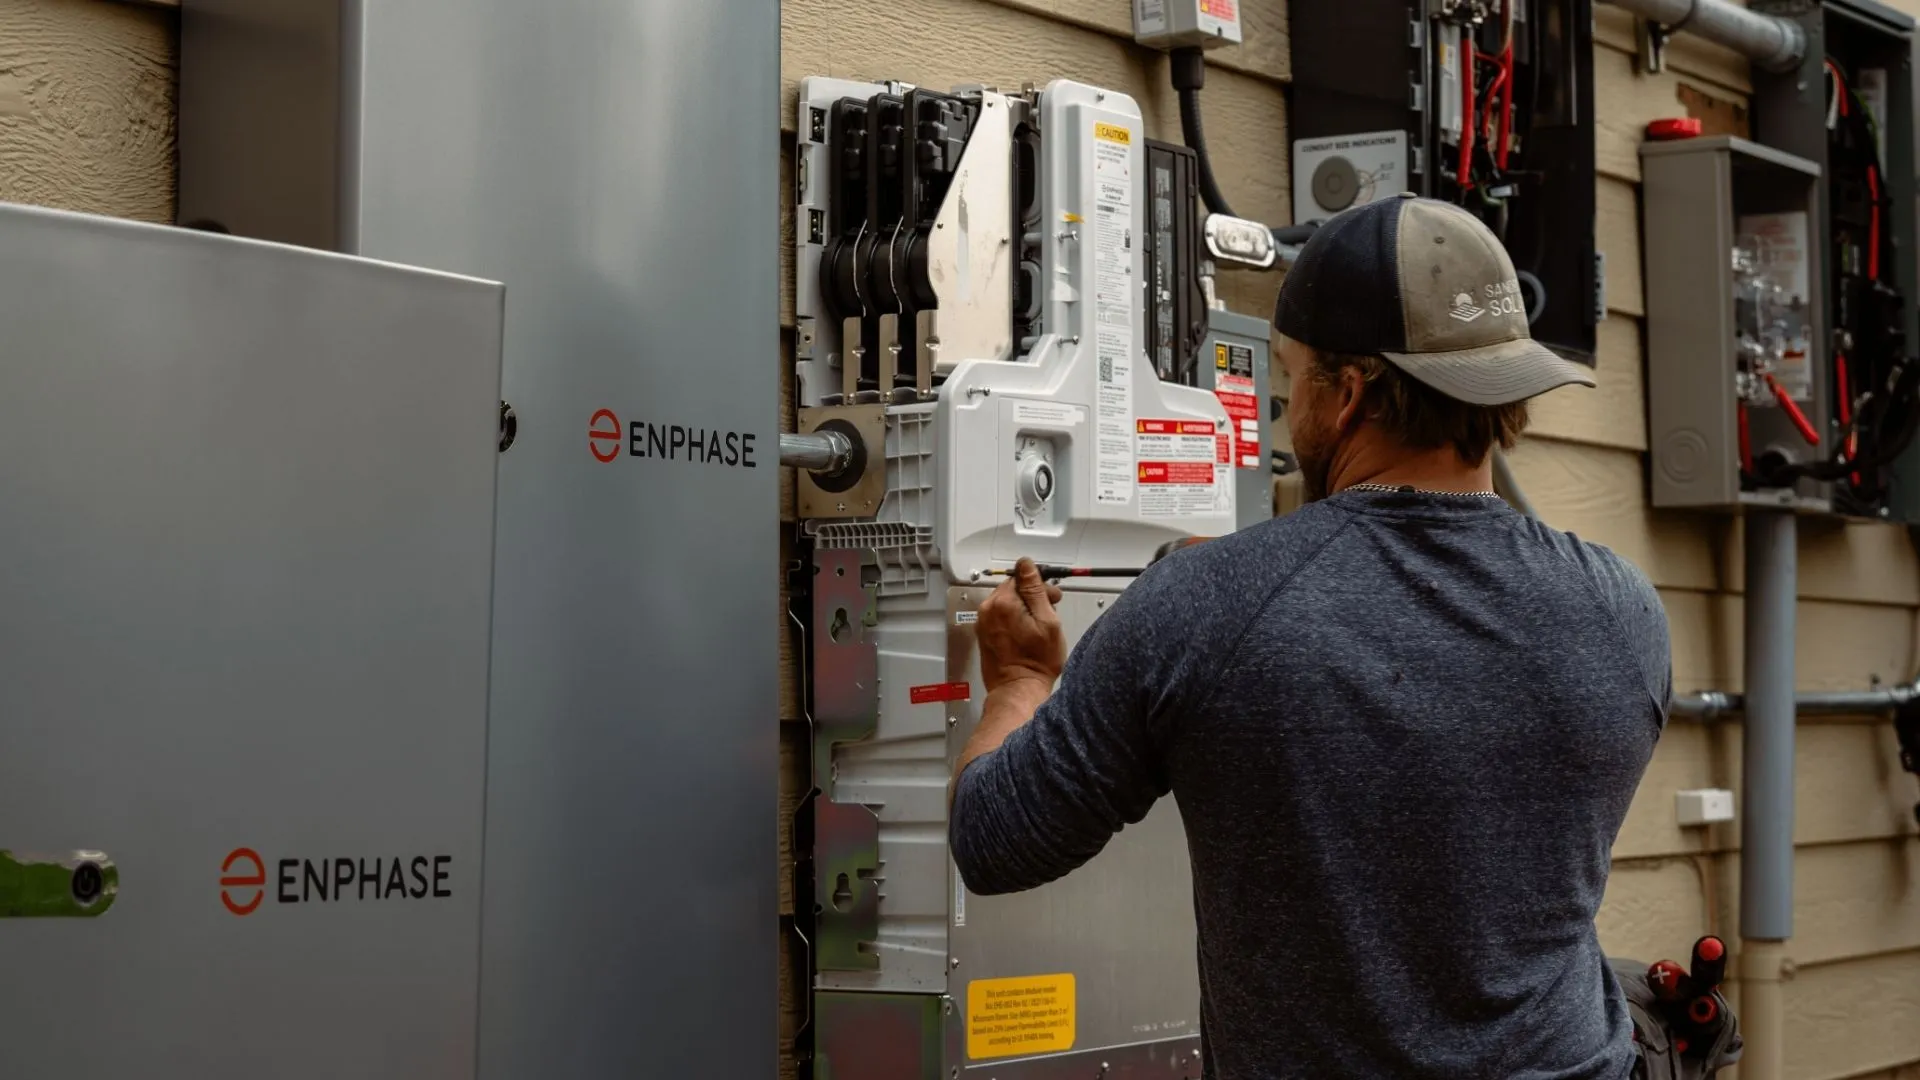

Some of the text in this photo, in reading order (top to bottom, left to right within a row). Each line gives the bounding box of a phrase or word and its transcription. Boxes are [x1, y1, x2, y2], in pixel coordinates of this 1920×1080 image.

[1102, 127, 1129, 141] CAUTION
[1302, 143, 1333, 152] CONDUIT
[629, 421, 757, 468] ENPHASE
[277, 855, 452, 903] ENPHASE
